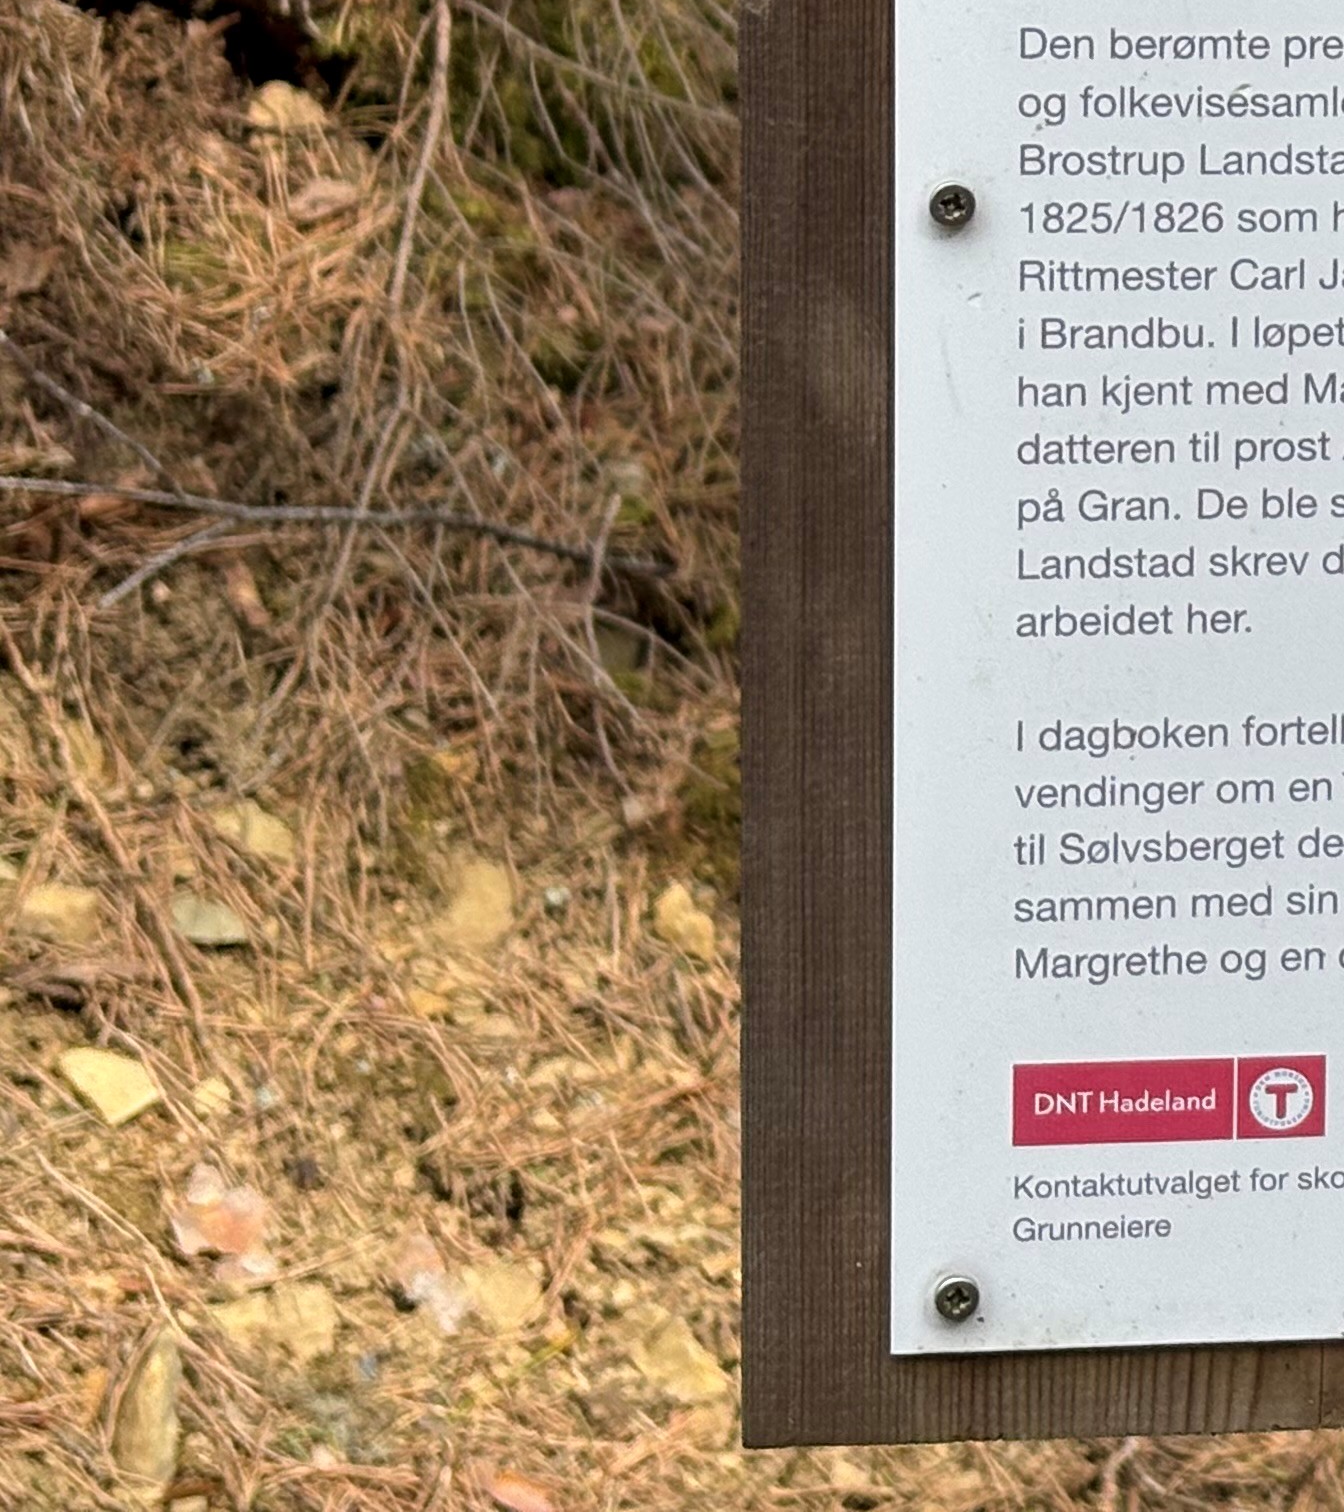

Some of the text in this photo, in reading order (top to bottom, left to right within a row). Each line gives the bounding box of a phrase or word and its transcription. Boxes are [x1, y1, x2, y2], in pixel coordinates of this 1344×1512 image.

[1019, 26, 1095, 61] Den
[1109, 27, 1271, 61] berømte
[1019, 143, 1186, 185] Brostrup
[1019, 200, 1224, 235] 1825/1826
[1237, 208, 1318, 234] som
[1019, 259, 1218, 293] Rittmester
[1229, 257, 1306, 291] Carl
[1017, 375, 1087, 408] han
[1102, 374, 1194, 416] kjent
[1206, 372, 1289, 406] med
[1017, 487, 1066, 532] på
[1077, 488, 1181, 523] Gran.
[1197, 488, 1249, 521] De
[1261, 486, 1318, 520] ble
[1016, 719, 1024, 753] I
[1038, 716, 1229, 759] dagboken
[1014, 774, 1206, 815] vendinger
[1215, 779, 1275, 805] om
[1288, 777, 1333, 803] en
[1013, 832, 1045, 866] til
[1059, 829, 1285, 869] Sølvsberget
[1015, 943, 1208, 986] Margrethe
[1219, 948, 1267, 982] og
[1280, 947, 1327, 973] en
[1033, 1088, 1217, 1116] DNT Hadeland
[1264, 1082, 1300, 1121] T
[1013, 1169, 1242, 1200] Kontaktutvalget
[1249, 1167, 1290, 1192] for
[1012, 1214, 1172, 1243] Grunneiere
